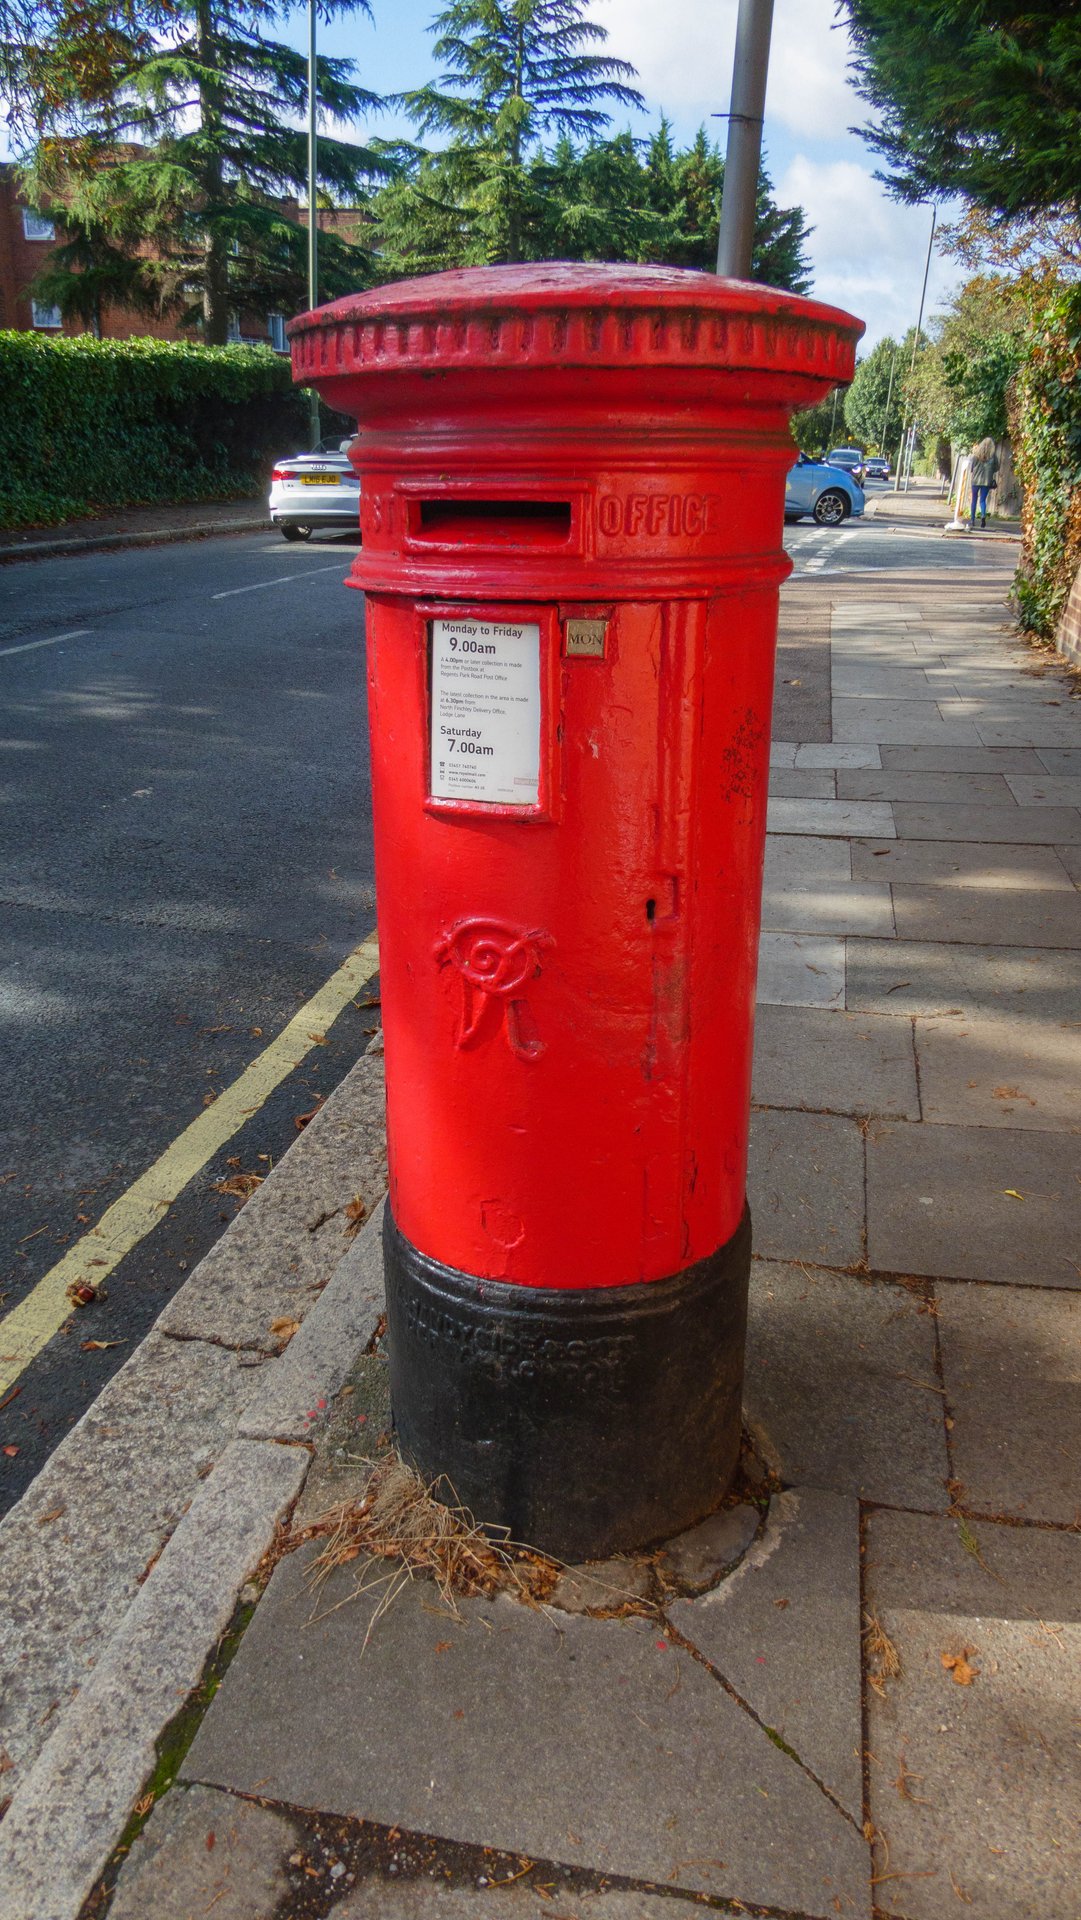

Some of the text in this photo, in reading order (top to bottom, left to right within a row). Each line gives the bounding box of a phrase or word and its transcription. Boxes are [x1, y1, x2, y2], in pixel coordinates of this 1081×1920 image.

[600, 494, 720, 537] OFFICE
[442, 622, 523, 639] Monday to Friday
[450, 637, 496, 654] 9.00am
[569, 633, 602, 645] MON
[441, 726, 481, 739] Saturday
[448, 739, 493, 755] 7.00am
